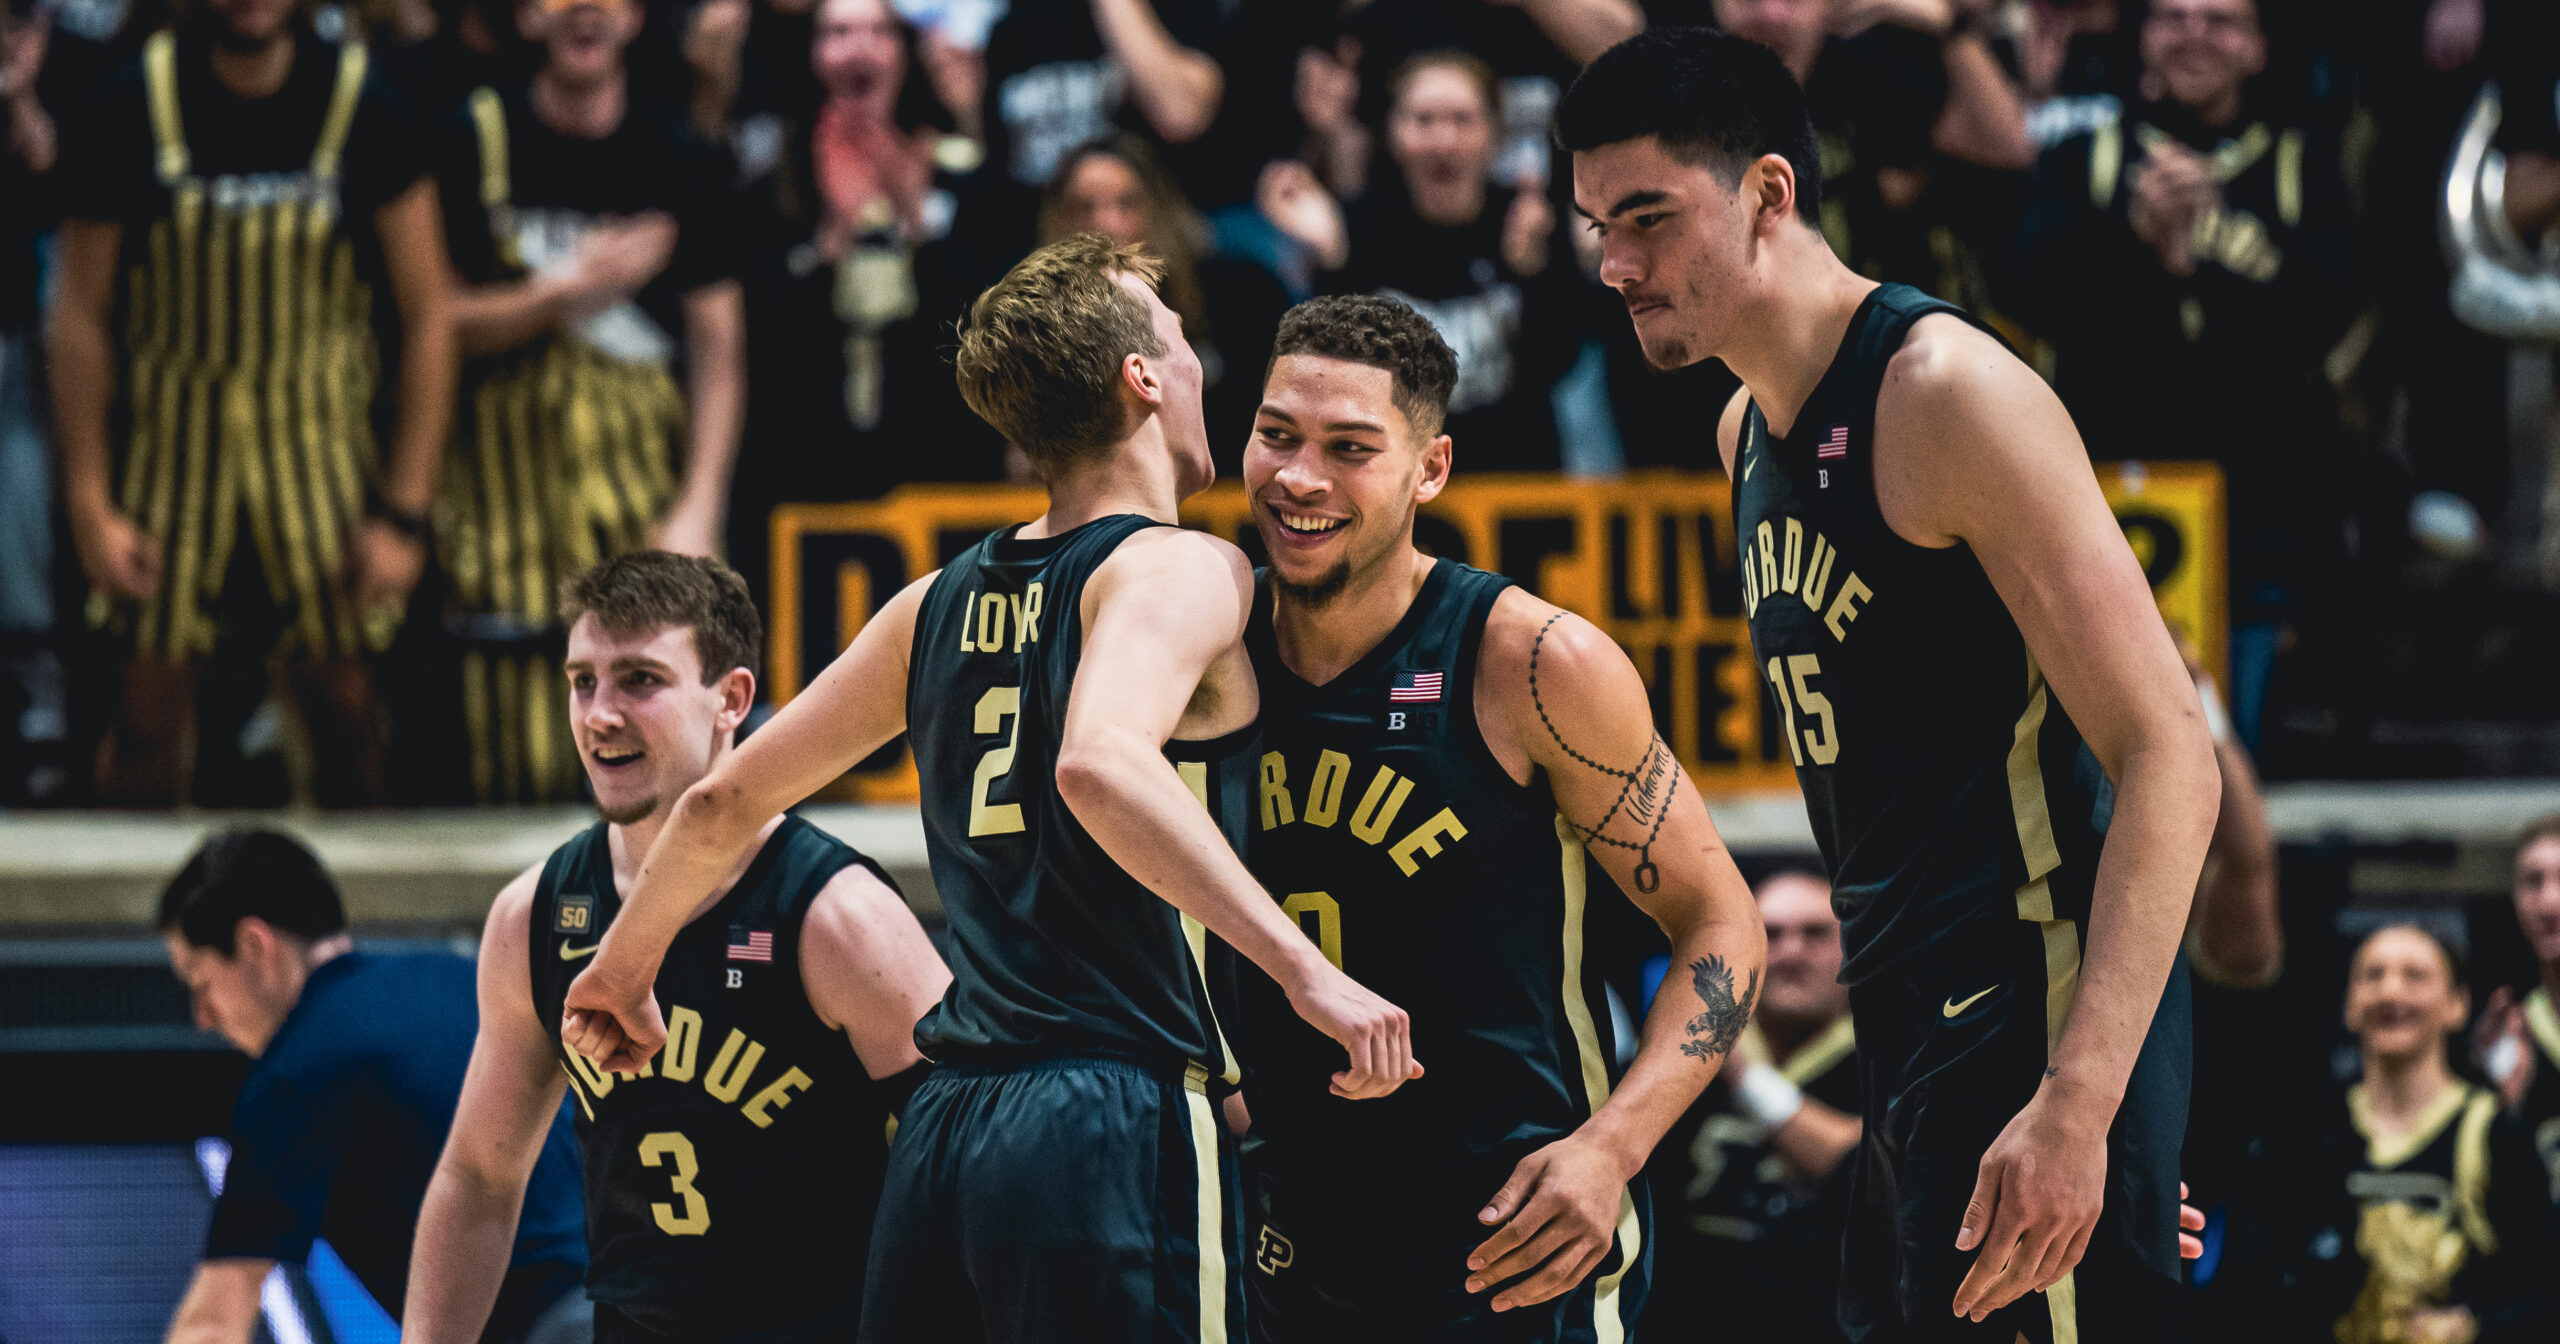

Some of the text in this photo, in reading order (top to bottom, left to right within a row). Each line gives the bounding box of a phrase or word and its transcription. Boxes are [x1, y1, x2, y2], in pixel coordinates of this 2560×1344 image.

[961, 581, 1043, 653] LOYR
[1743, 516, 1874, 644] URDUE
[968, 687, 1026, 838] 2
[1768, 653, 1840, 767] 15
[1260, 749, 1469, 878] RDUE
[560, 906, 588, 929] 50
[559, 1004, 814, 1130] UDUE
[637, 1131, 712, 1236] 3
[1257, 1224, 1294, 1276] P
